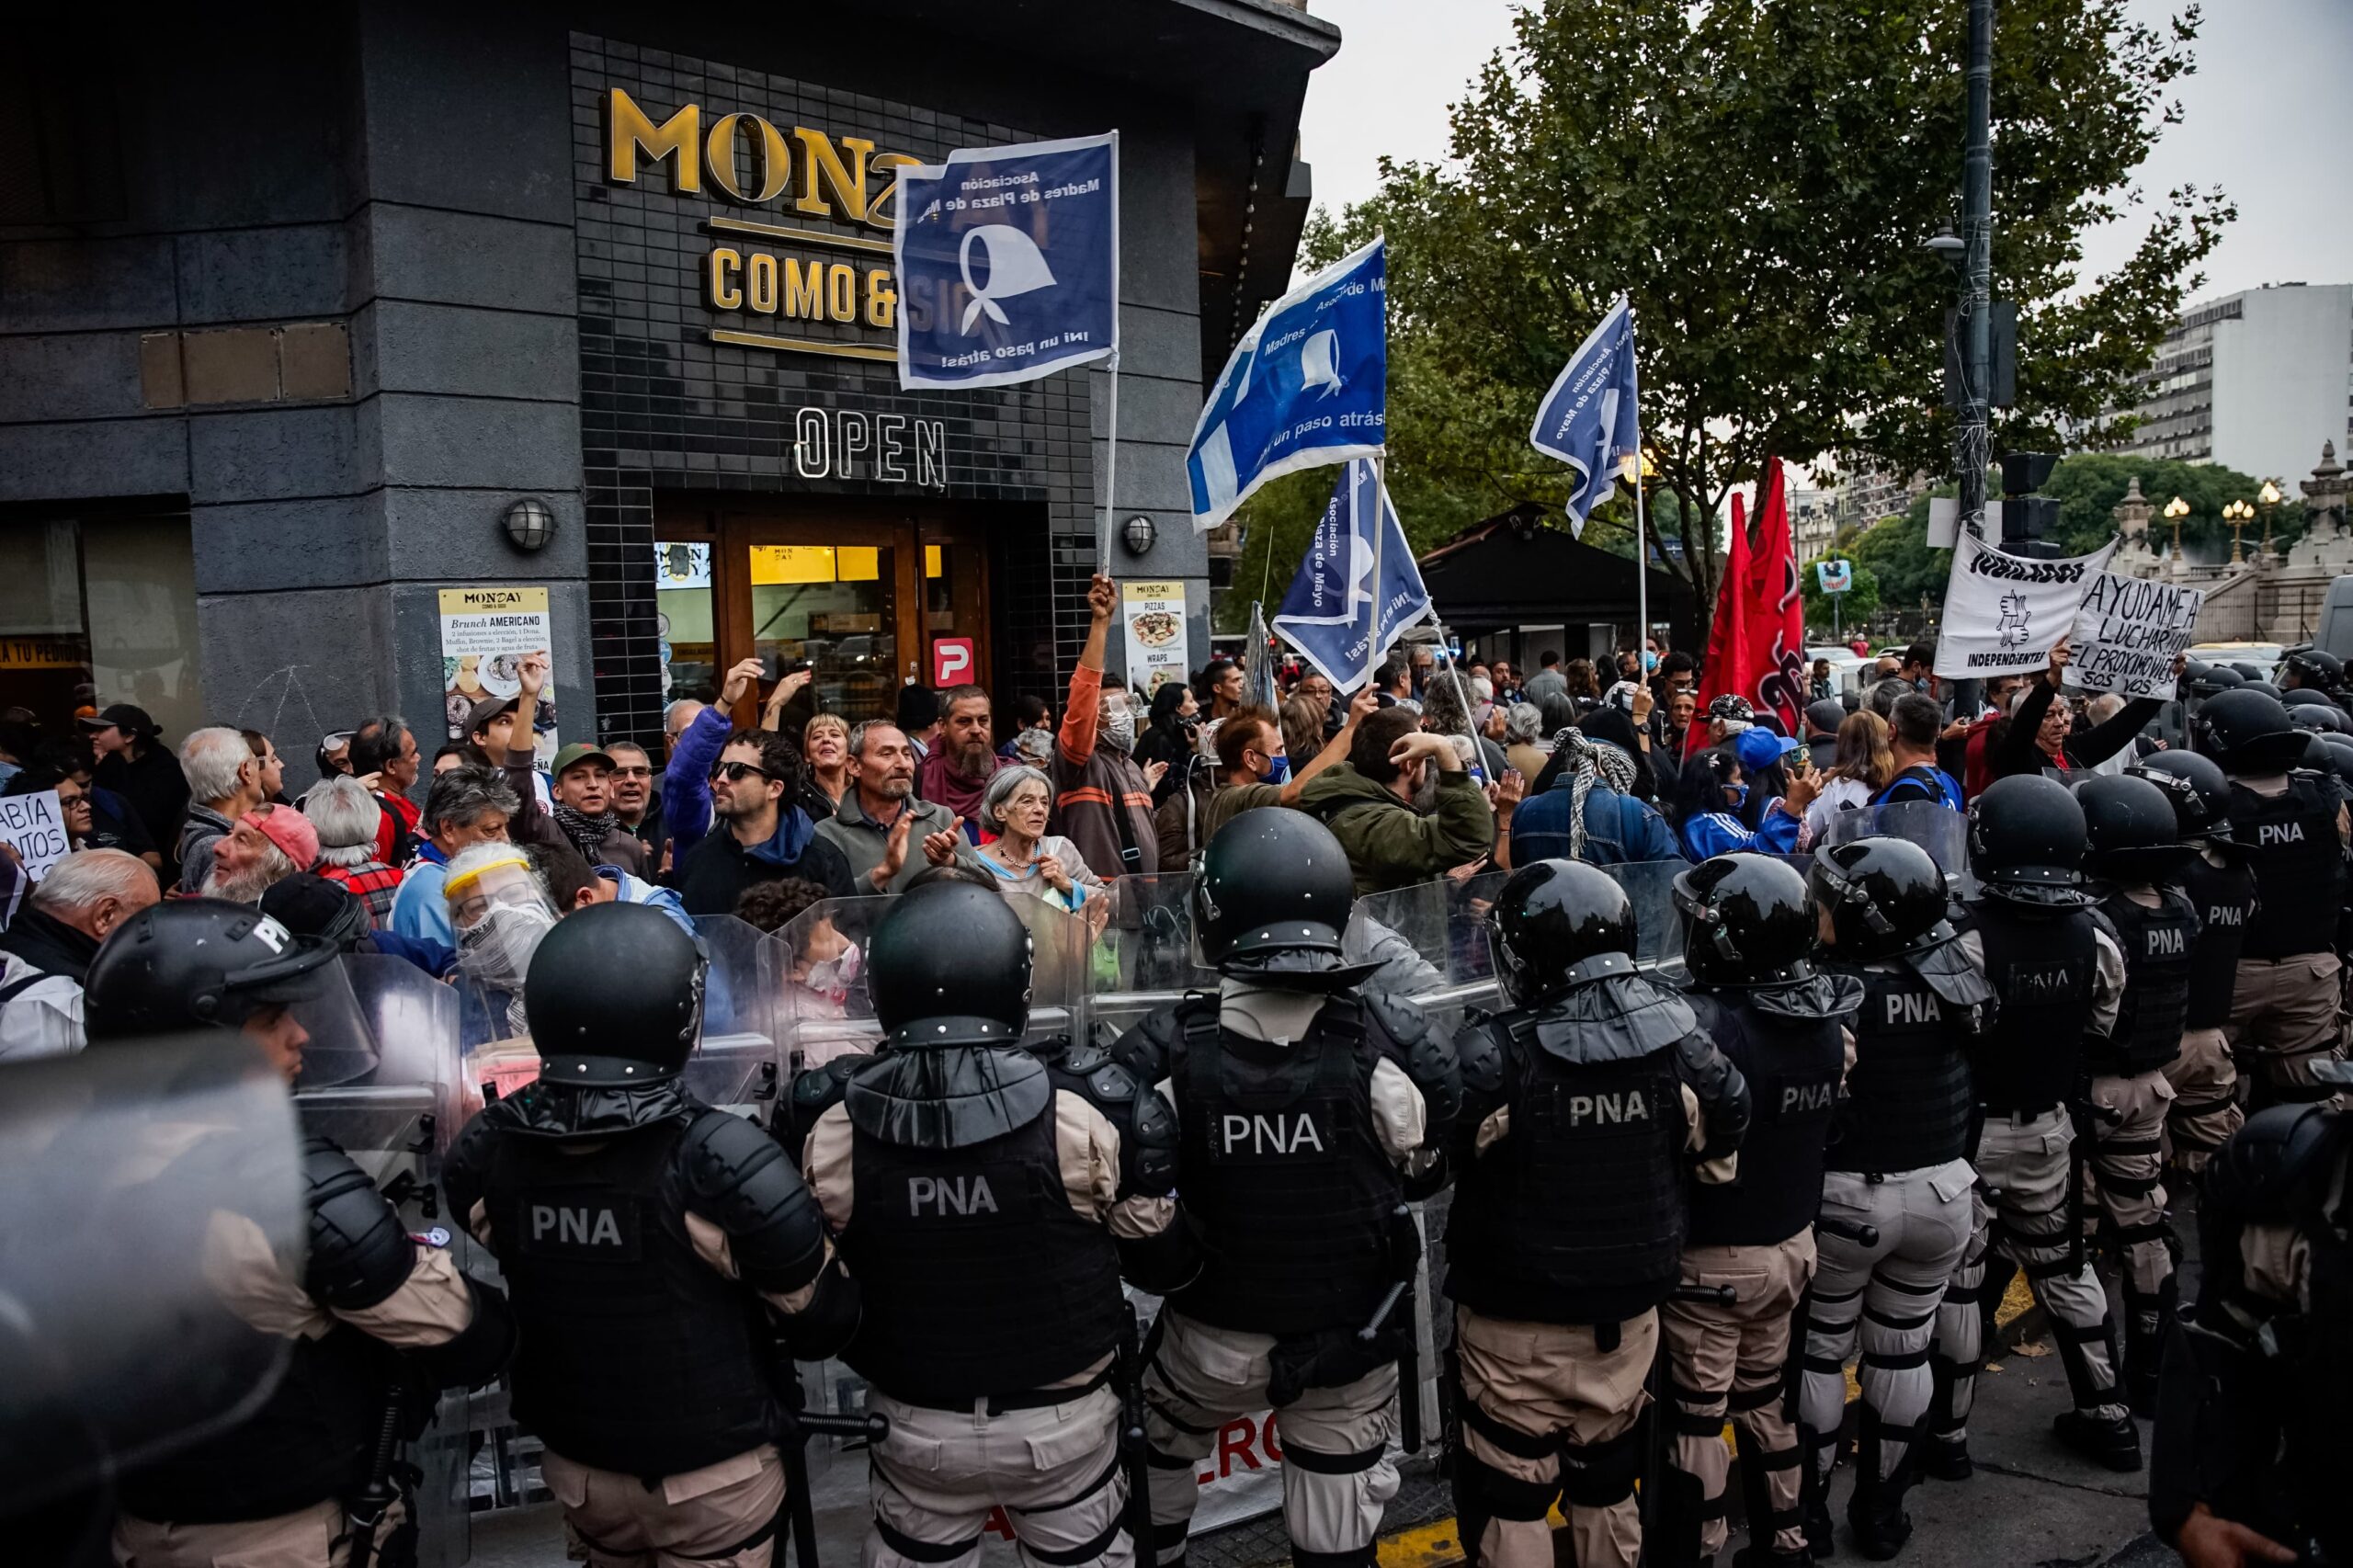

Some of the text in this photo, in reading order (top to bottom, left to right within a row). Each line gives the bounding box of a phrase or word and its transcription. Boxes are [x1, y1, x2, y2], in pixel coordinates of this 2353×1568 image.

[711, 247, 857, 324] COMO
[1265, 326, 1306, 357] Madres
[1294, 415, 1332, 438] paso
[794, 407, 947, 493] OPEN
[1314, 552, 1325, 569] de
[464, 592, 522, 603] MONDAY
[1313, 573, 1325, 608] Mayo
[1144, 602, 1165, 610] PIZZAS
[451, 616, 540, 629] Brunch AMERICANO
[14, 643, 31, 662] TU
[1147, 653, 1167, 663] WRAPS
[2081, 671, 2116, 687] SOS
[2258, 822, 2305, 846] PNA
[2208, 904, 2243, 926] PNA
[2146, 927, 2185, 956] PNA
[1885, 991, 1941, 1024] PNA
[1569, 1091, 1649, 1128] PNA
[1779, 1082, 1833, 1114] PNA
[1222, 1112, 1324, 1155] PNA
[908, 1176, 999, 1217] PNA
[531, 1204, 623, 1246] PNA
